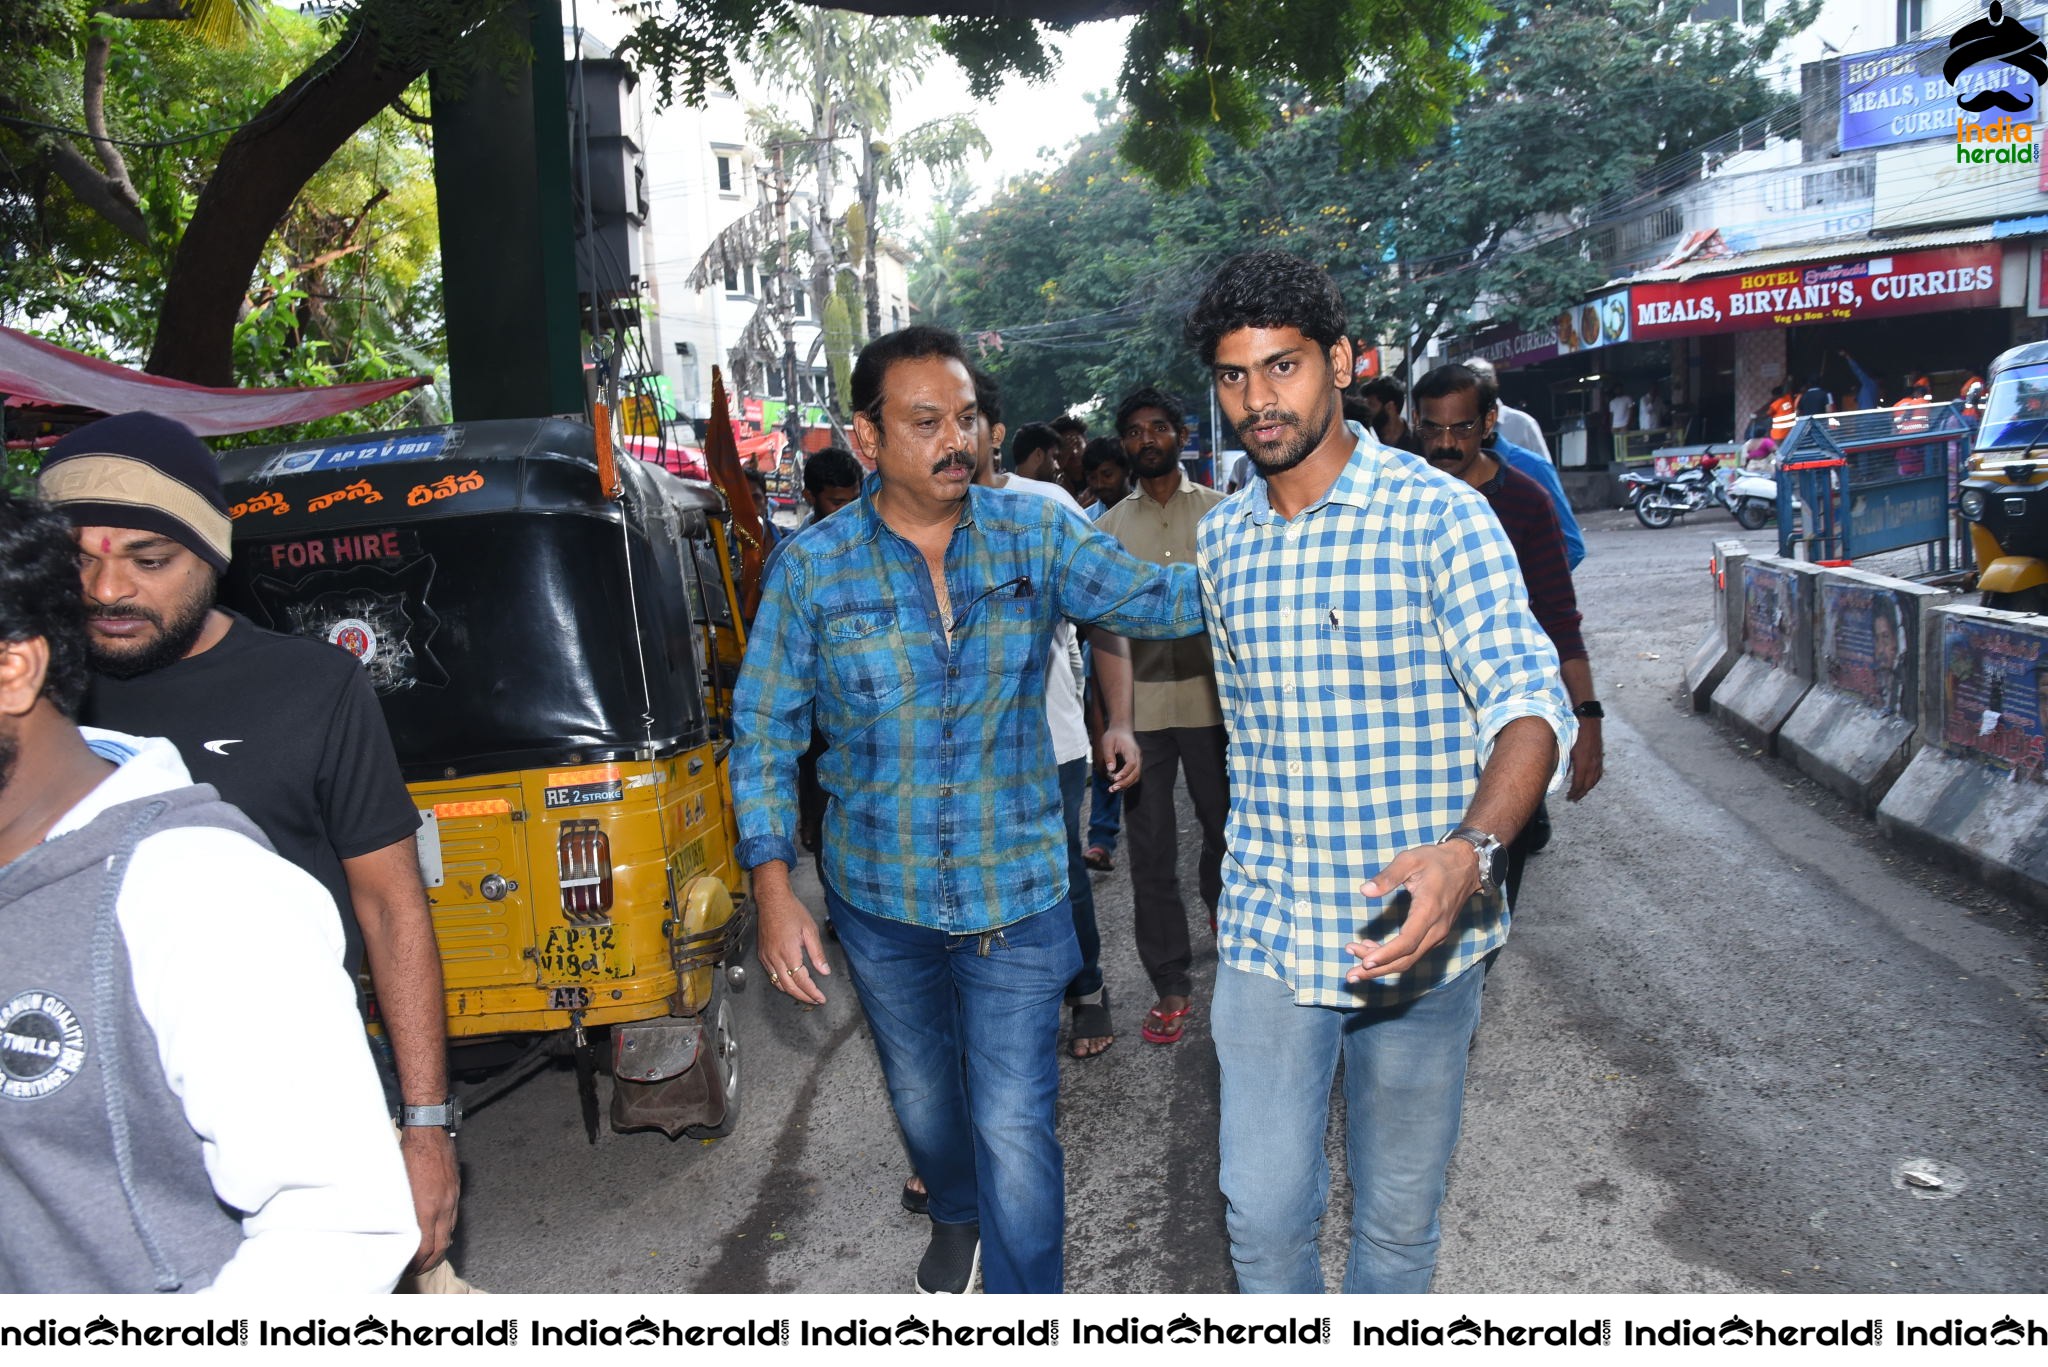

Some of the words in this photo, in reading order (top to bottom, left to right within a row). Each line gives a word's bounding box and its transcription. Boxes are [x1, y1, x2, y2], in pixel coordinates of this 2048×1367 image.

[1848, 53, 1916, 84] HOTEL
[1848, 84, 1920, 114] MEALS,
[1741, 272, 1798, 290] HOTEL
[1637, 296, 1722, 326] MEALS,
[1871, 265, 1993, 302] CURRIES
[1774, 314, 1792, 324] Veg
[1832, 308, 1851, 318] Veg
[327, 451, 355, 464] AP
[357, 448, 375, 460] 12
[380, 446, 396, 458] V
[396, 441, 431, 456] 1811
[270, 540, 327, 570] FOR
[332, 531, 401, 565] HIRE
[546, 788, 570, 805] RE
[573, 790, 581, 803] 2
[581, 790, 622, 802] STROKE
[554, 986, 589, 1008] ATS
[42, 996, 84, 1048] QUALITY
